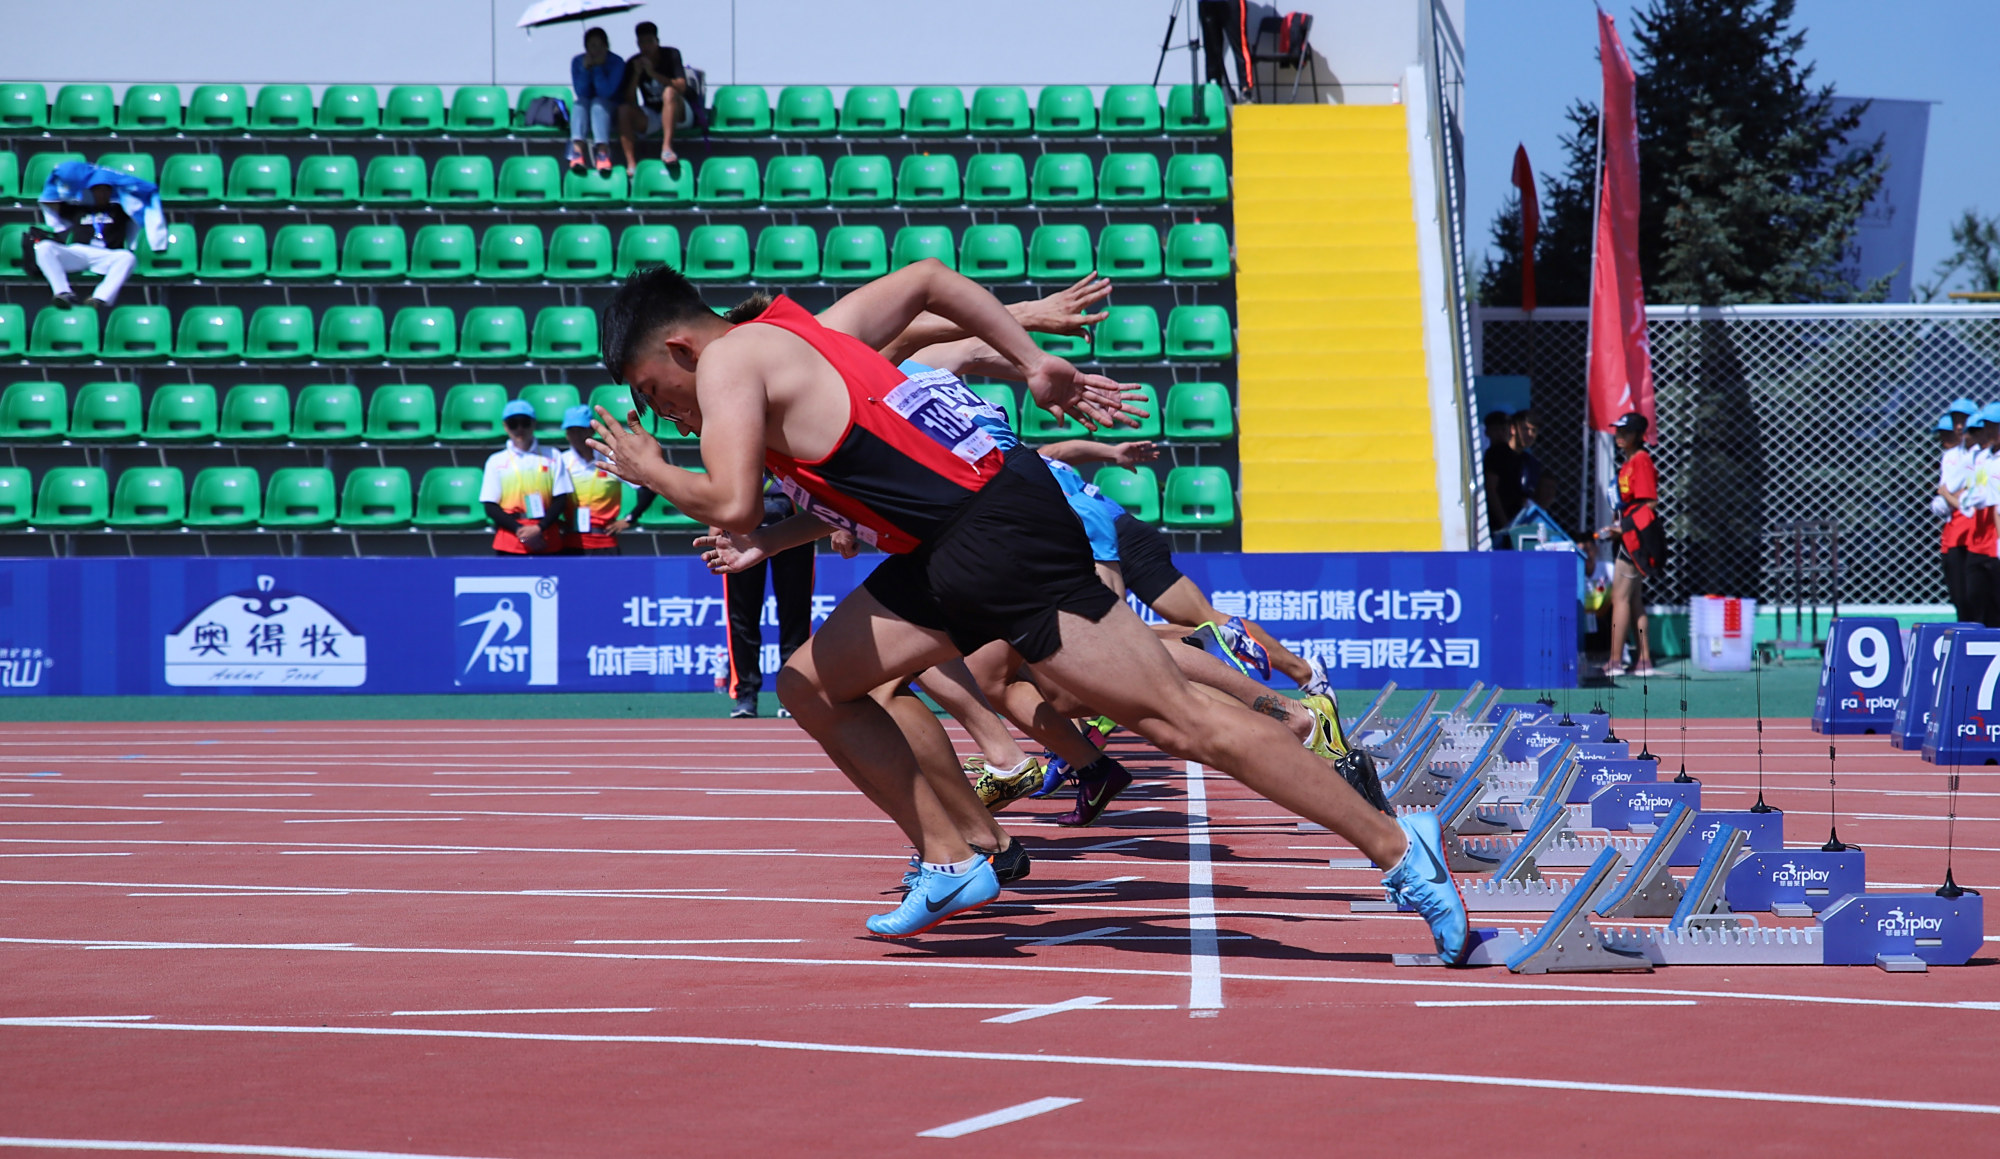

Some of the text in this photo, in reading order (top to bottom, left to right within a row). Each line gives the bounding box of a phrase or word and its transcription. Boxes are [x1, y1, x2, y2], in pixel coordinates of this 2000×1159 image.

[190, 622, 342, 657] 奥得牧
[484, 645, 529, 672] TST
[1847, 626, 1890, 688] 9
[1934, 640, 1952, 708] 7
[1966, 641, 2000, 710] 7
